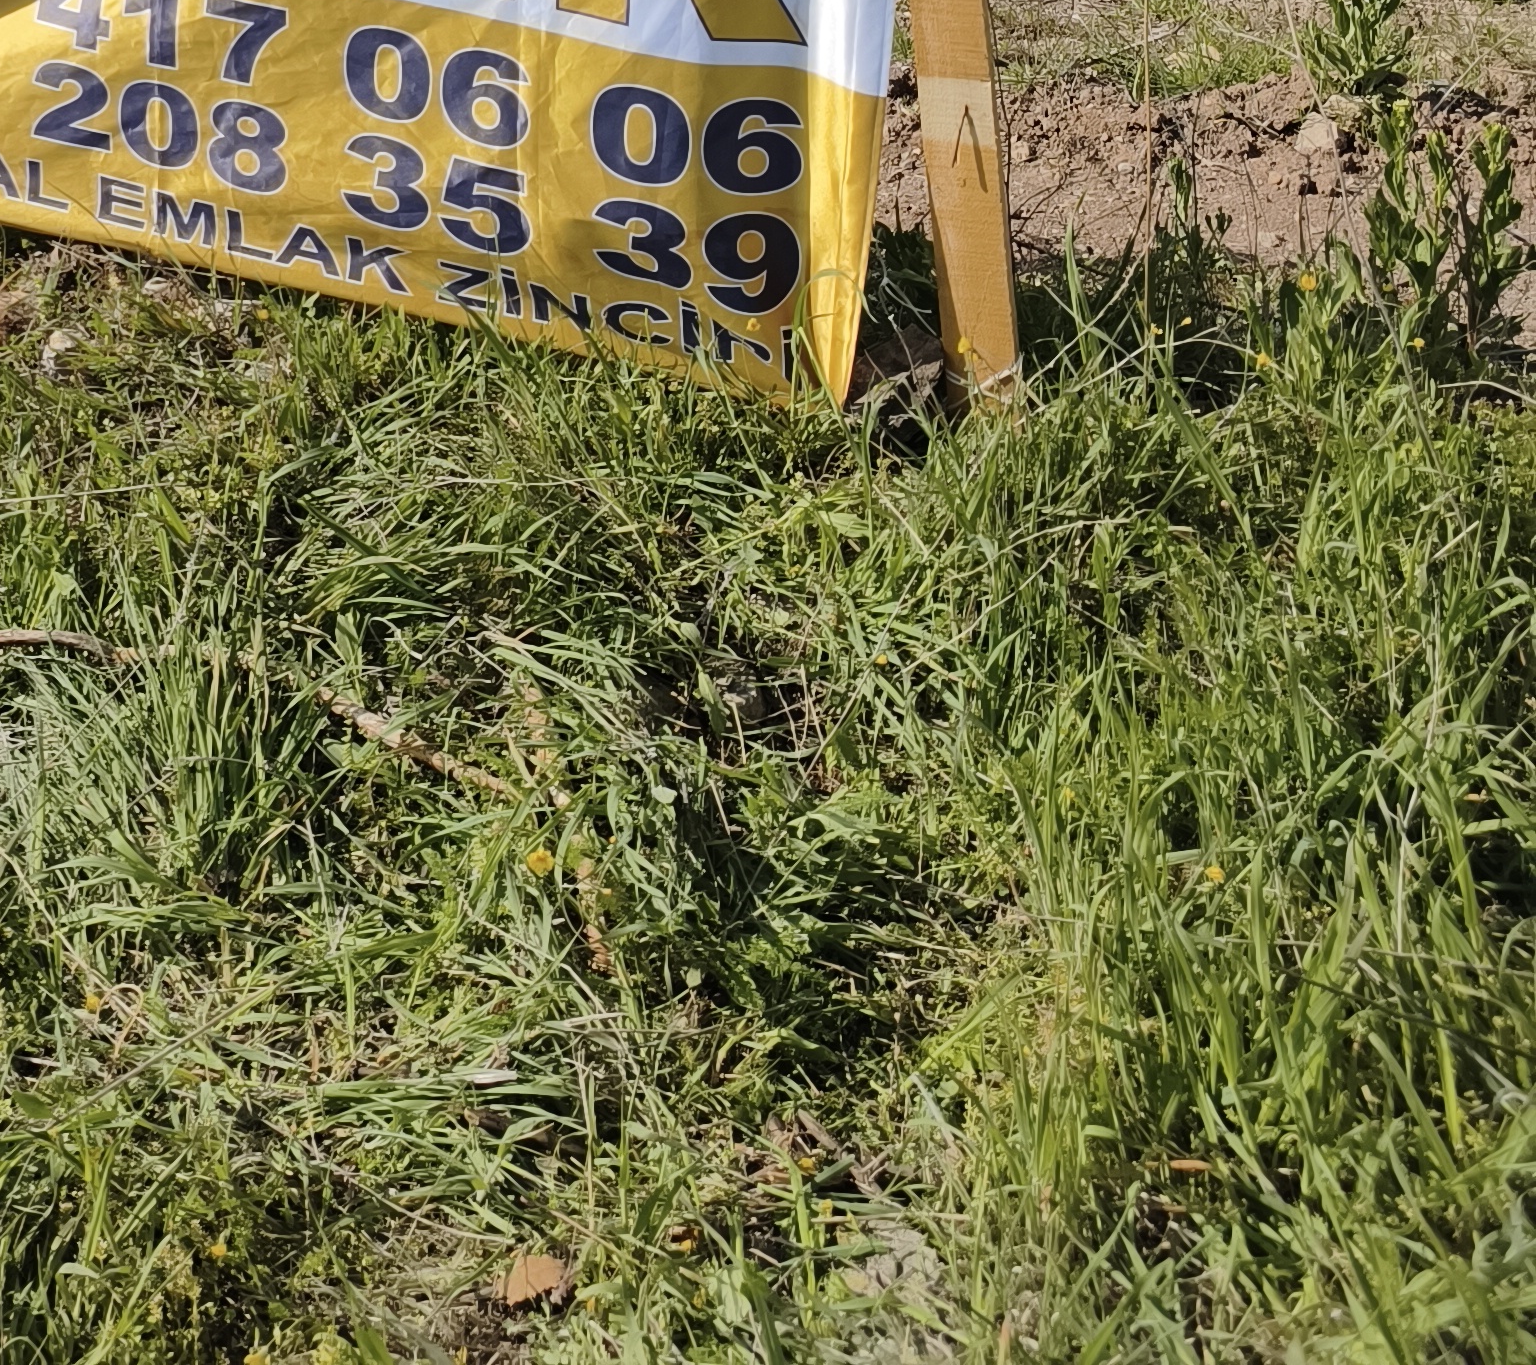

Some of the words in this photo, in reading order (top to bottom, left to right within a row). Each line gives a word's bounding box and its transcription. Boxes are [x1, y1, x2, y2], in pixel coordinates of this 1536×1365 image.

[31, 62, 288, 195] 208
[341, 134, 533, 256] 35
[592, 198, 803, 315] 39
[343, 24, 531, 150] 06
[590, 84, 805, 195] 06
[97, 174, 415, 297] EMLAK
